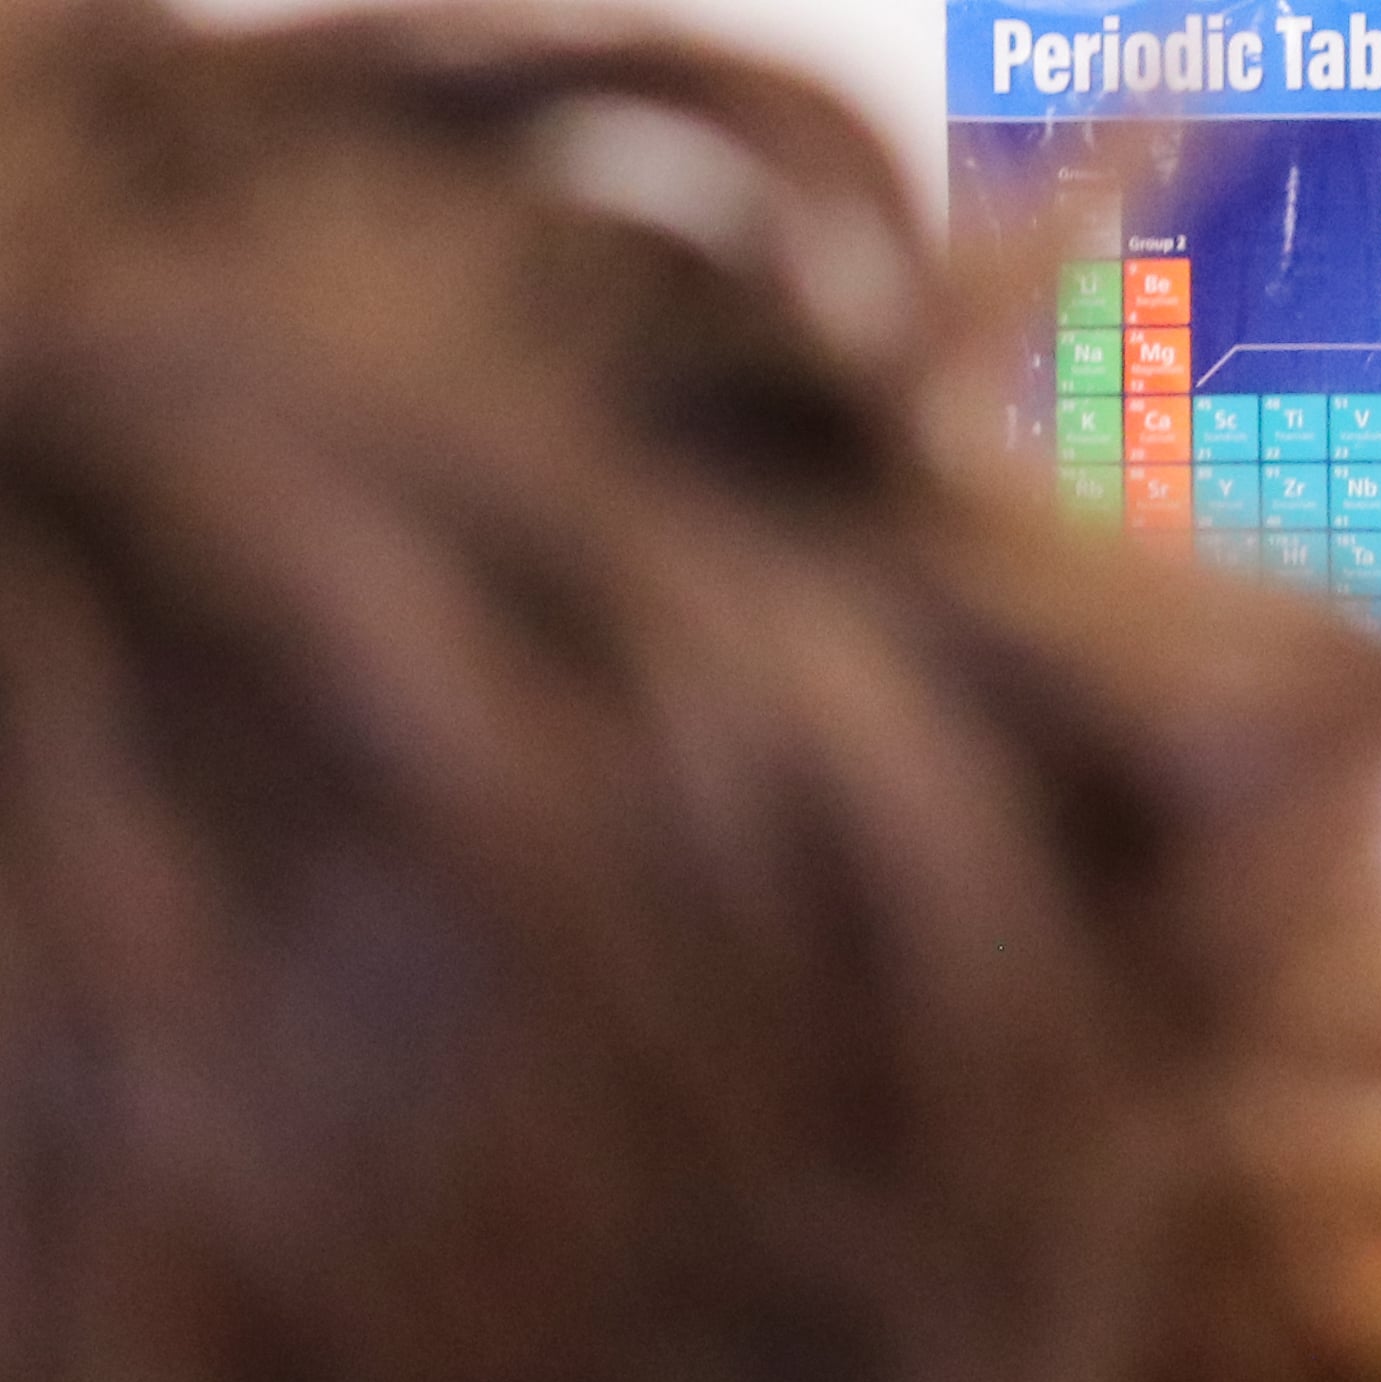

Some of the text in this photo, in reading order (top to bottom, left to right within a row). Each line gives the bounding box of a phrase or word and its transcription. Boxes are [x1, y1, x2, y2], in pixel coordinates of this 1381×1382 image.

[993, 16, 1264, 94] Periodic
[1129, 234, 1187, 253] Group 2
[1145, 276, 1170, 293] Be
[1075, 345, 1103, 363] Na
[1140, 345, 1174, 366] Mg
[1145, 414, 1171, 430] Ca
[1215, 413, 1237, 430] Sc
[1284, 411, 1303, 428] Ti
[1354, 411, 1369, 428] V
[1347, 479, 1377, 497] Nb
